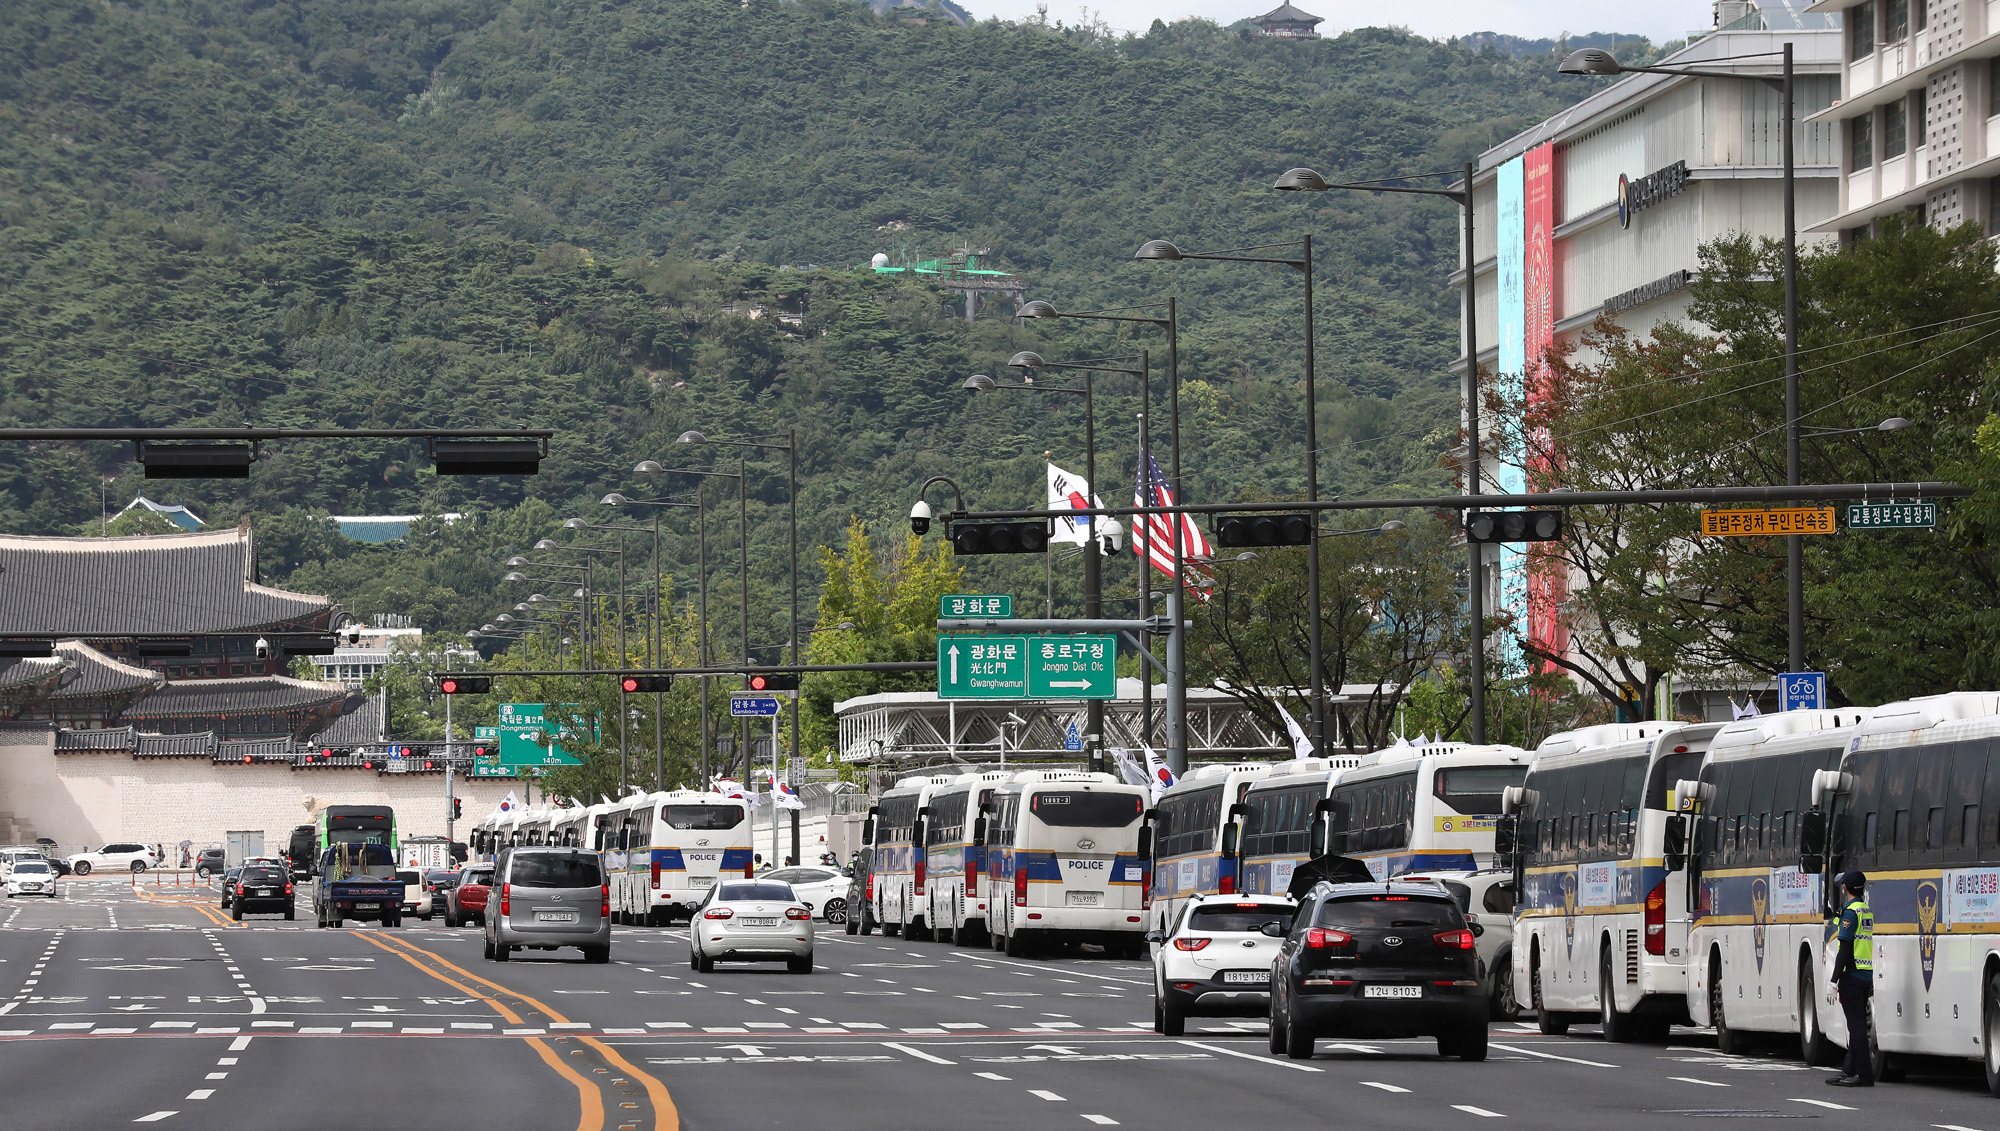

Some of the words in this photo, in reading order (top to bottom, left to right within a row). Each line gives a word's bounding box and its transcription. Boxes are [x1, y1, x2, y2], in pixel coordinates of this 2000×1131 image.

[1852, 506, 1933, 524] 교통정보수집장치
[1707, 514, 1764, 532] 불법주정차
[1768, 514, 1790, 530] 무인
[1794, 512, 1828, 530] 단속중
[951, 598, 1002, 614] 광화문
[970, 644, 1018, 660] 광화문
[1040, 643, 1104, 659] 종로구청
[970, 662, 1007, 675] 光化門
[1042, 661, 1068, 673] Jongno
[1072, 661, 1086, 672] Dist
[1091, 661, 1104, 672] Ofc
[970, 678, 1024, 690] Gwanghwamun
[734, 700, 758, 708] 삼봉로
[502, 715, 522, 724] 독립문
[1068, 860, 1104, 870] POLICE
[1618, 874, 1632, 898] POLICE
[1228, 972, 1248, 981] 181보
[1370, 987, 1388, 996] 12너
[1392, 987, 1417, 996] 8103
